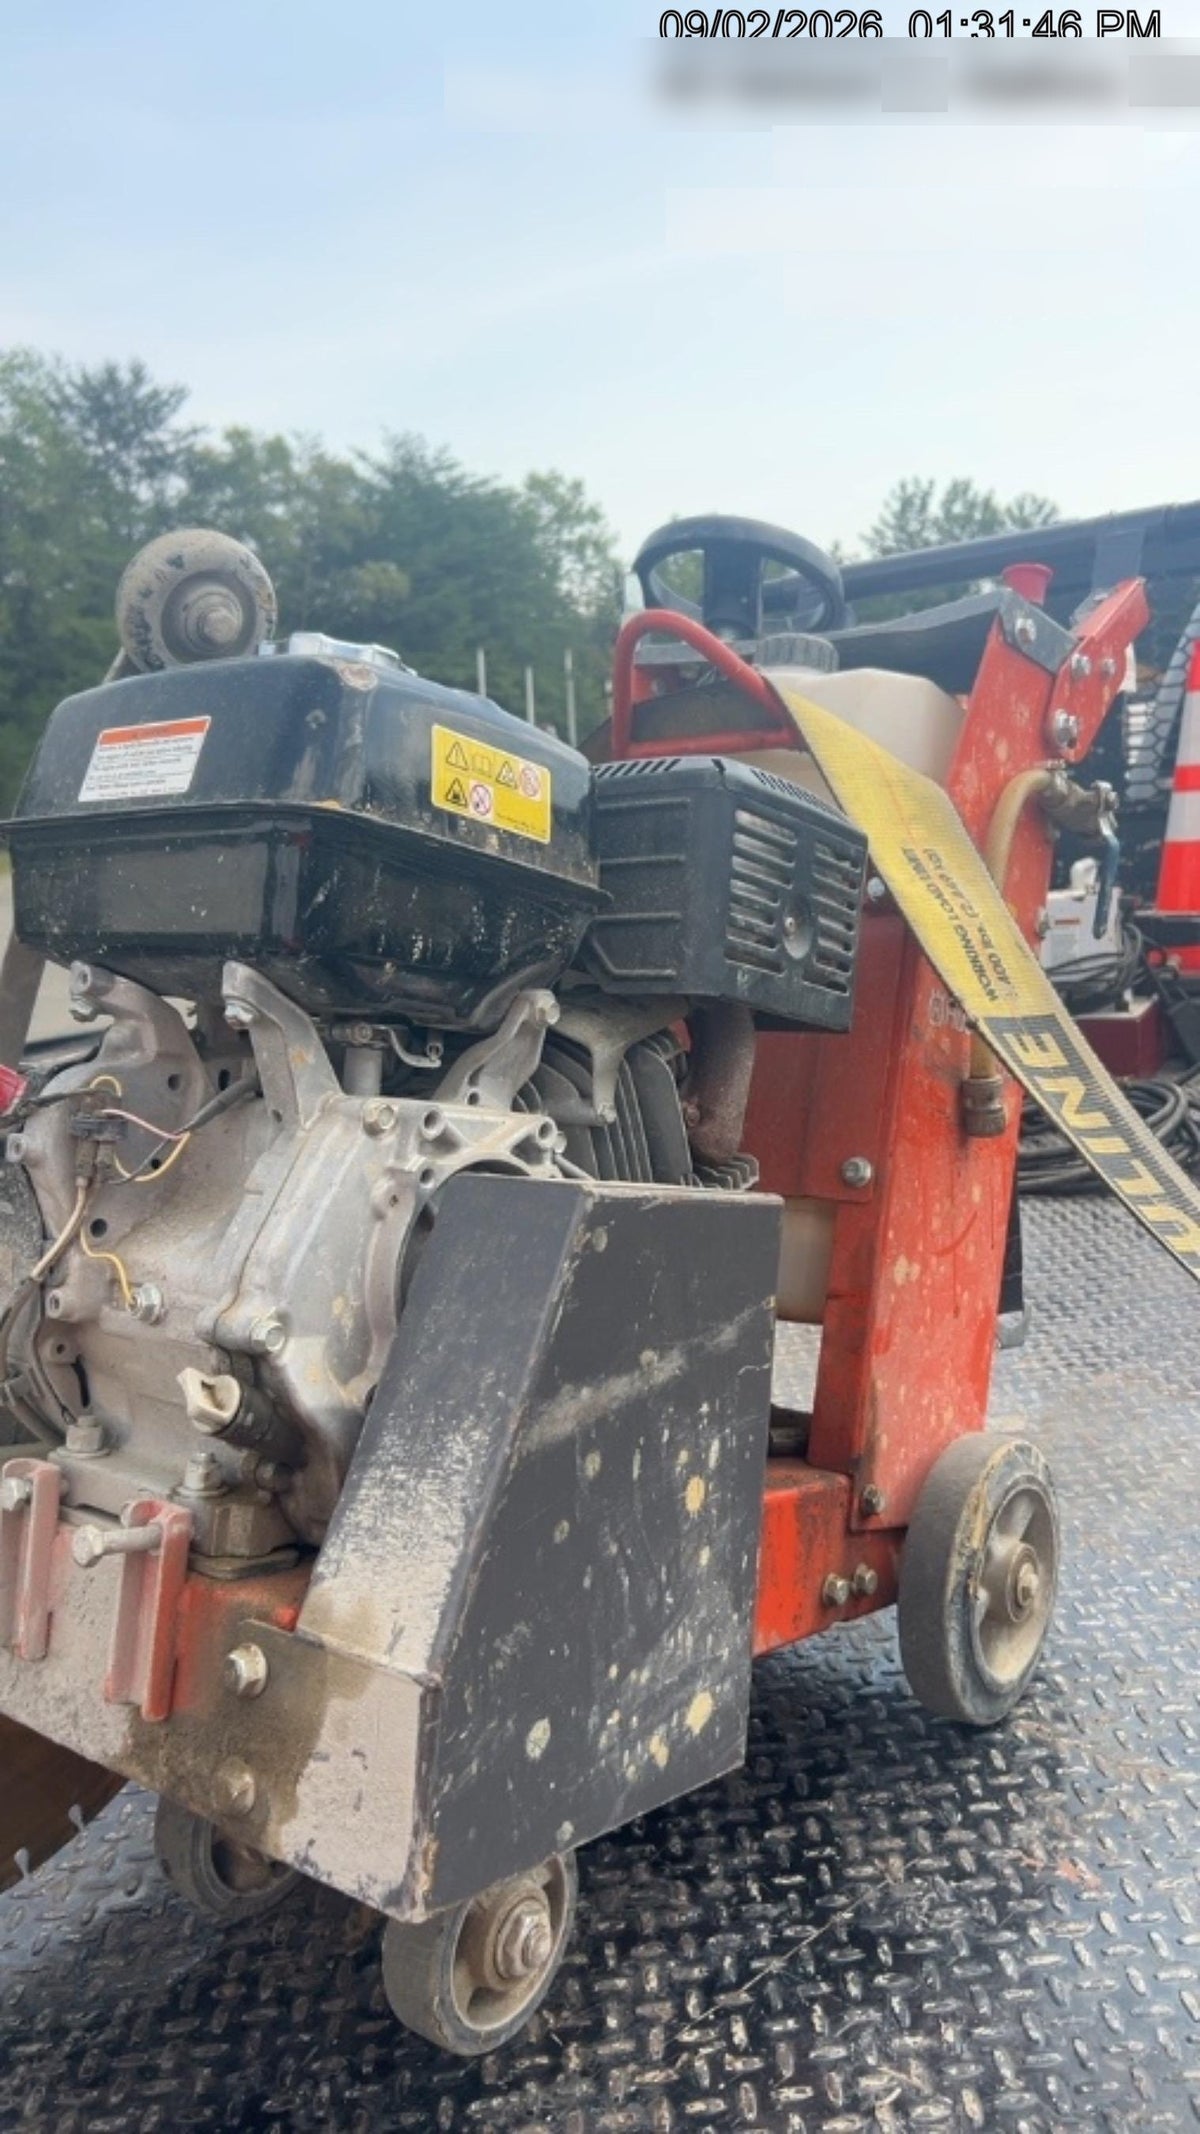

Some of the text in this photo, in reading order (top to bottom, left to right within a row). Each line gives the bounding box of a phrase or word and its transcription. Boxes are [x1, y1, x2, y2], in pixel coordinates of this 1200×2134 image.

[902, 848, 999, 1001] WORKING LOAD LIMIT
[1005, 1032, 1200, 1254] ULINE
